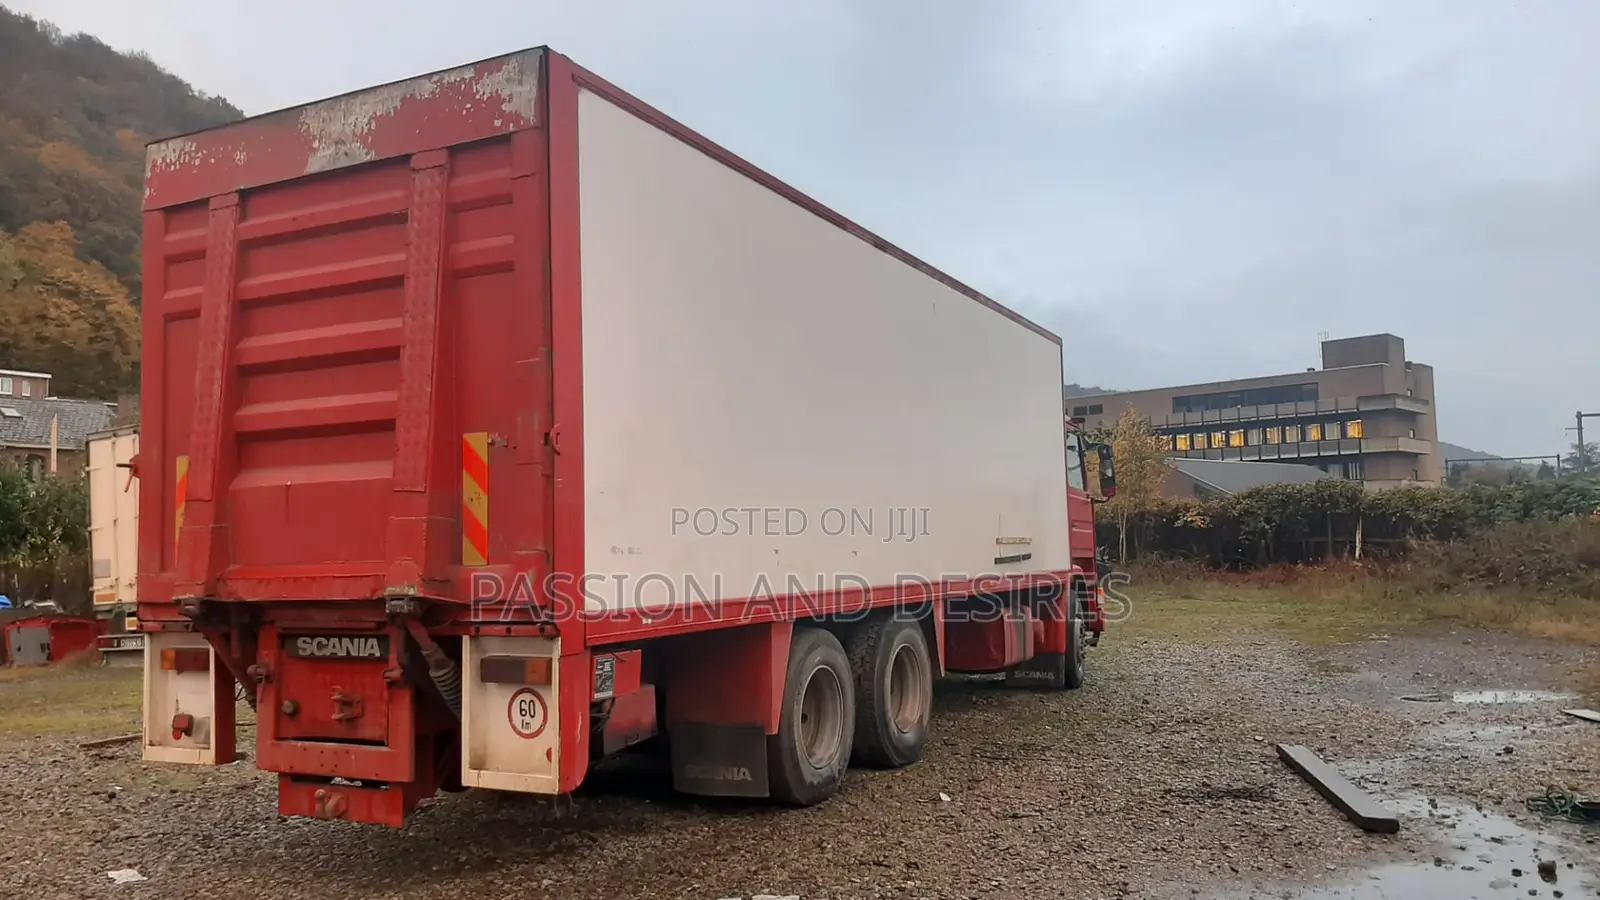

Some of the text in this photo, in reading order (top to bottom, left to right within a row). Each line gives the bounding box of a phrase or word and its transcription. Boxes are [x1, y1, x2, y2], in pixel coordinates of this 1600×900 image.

[297, 637, 380, 656] SCANIA
[1014, 671, 1055, 680] SCANIA
[519, 699, 536, 718] 60
